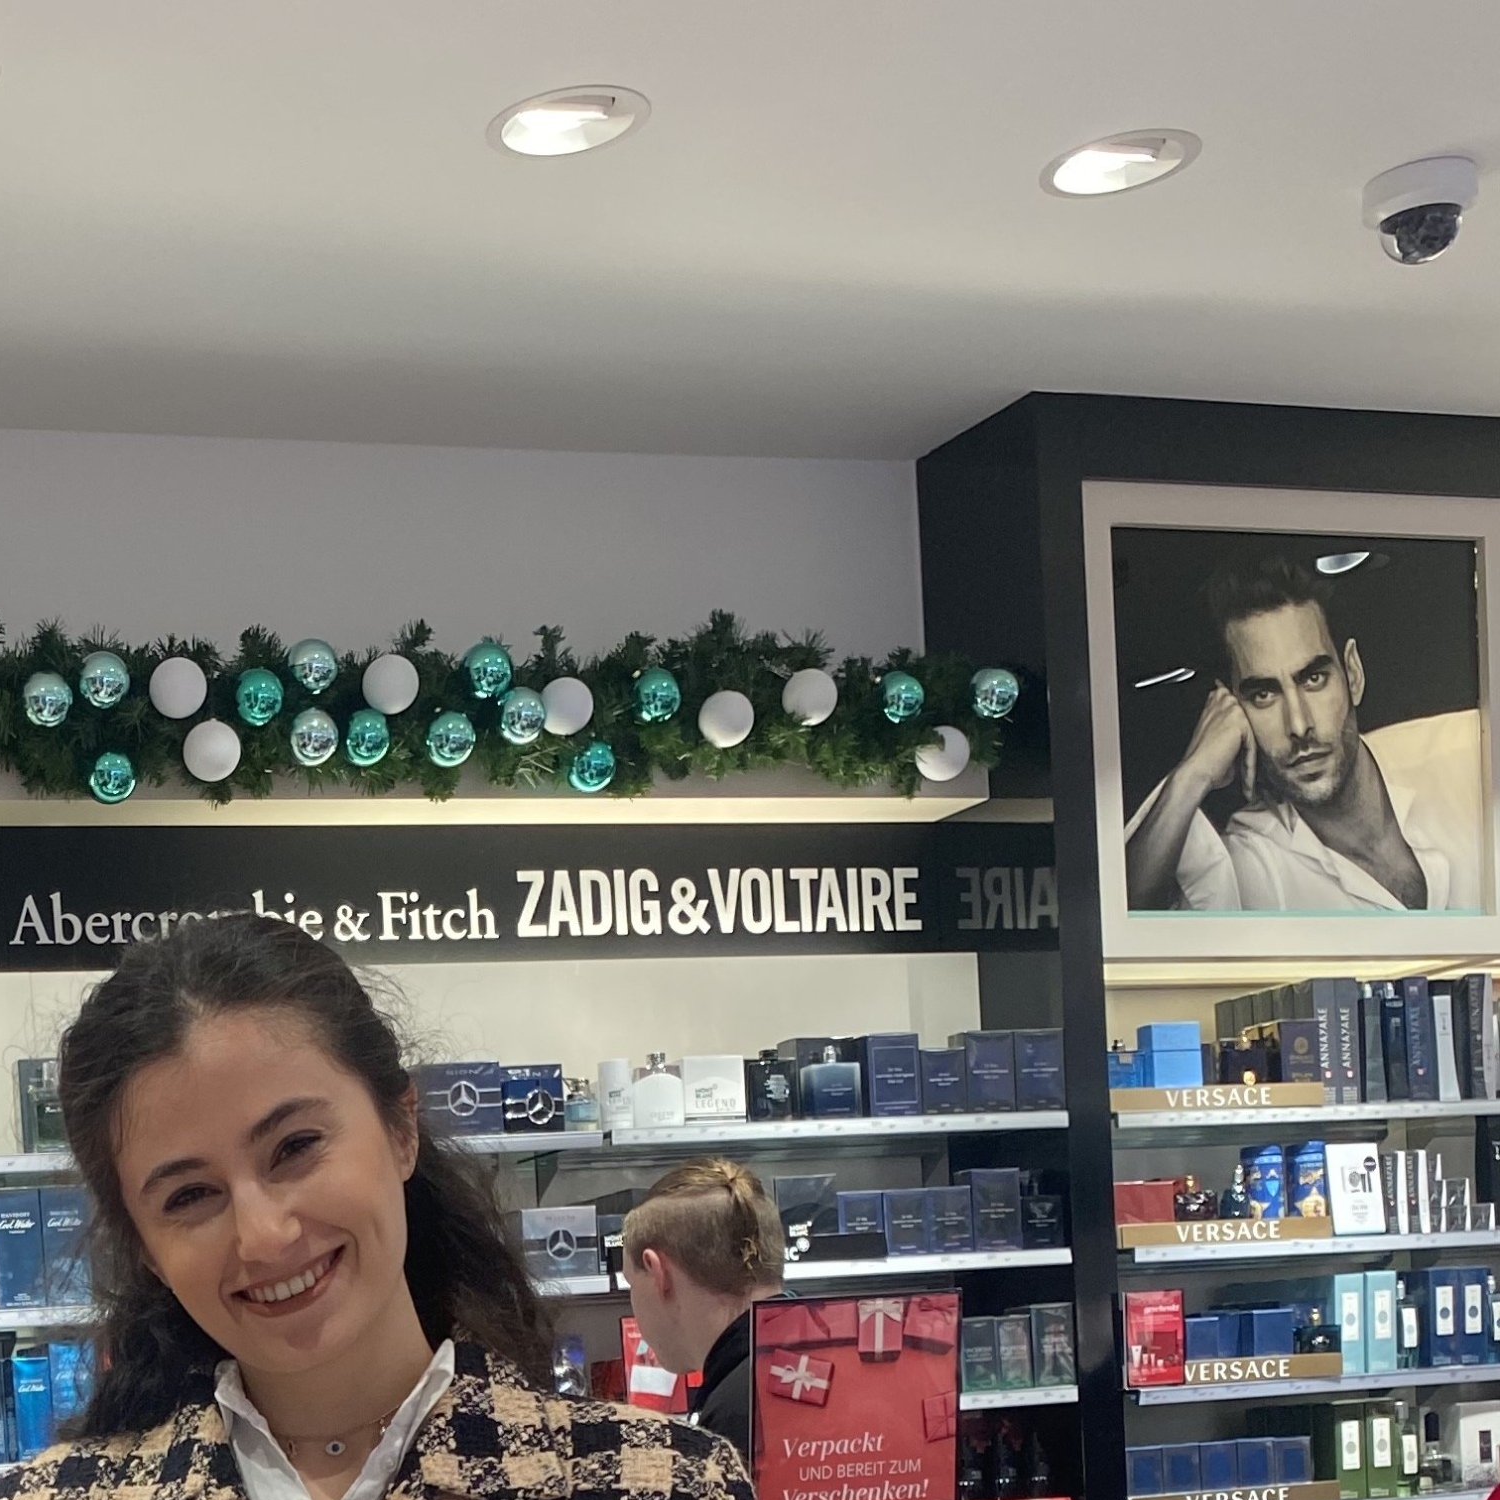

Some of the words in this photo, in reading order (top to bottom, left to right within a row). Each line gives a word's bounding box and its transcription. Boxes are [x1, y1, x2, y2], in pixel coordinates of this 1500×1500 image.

[333, 904, 371, 942] &
[378, 888, 499, 942] Fitch
[515, 866, 923, 938] ZADIG&VOLTAIRE
[1317, 1007, 1330, 1069] ANNAYAKE
[1339, 1007, 1352, 1069] ANNAYAKE
[1165, 1086, 1273, 1109] VERSACE
[1176, 1220, 1281, 1243] VERSACE
[1184, 1359, 1291, 1382] VERSACE
[782, 1431, 885, 1461] Verpackt
[799, 1464, 833, 1482] UND
[837, 1460, 885, 1478] BEREIT
[888, 1458, 922, 1475] ZUM
